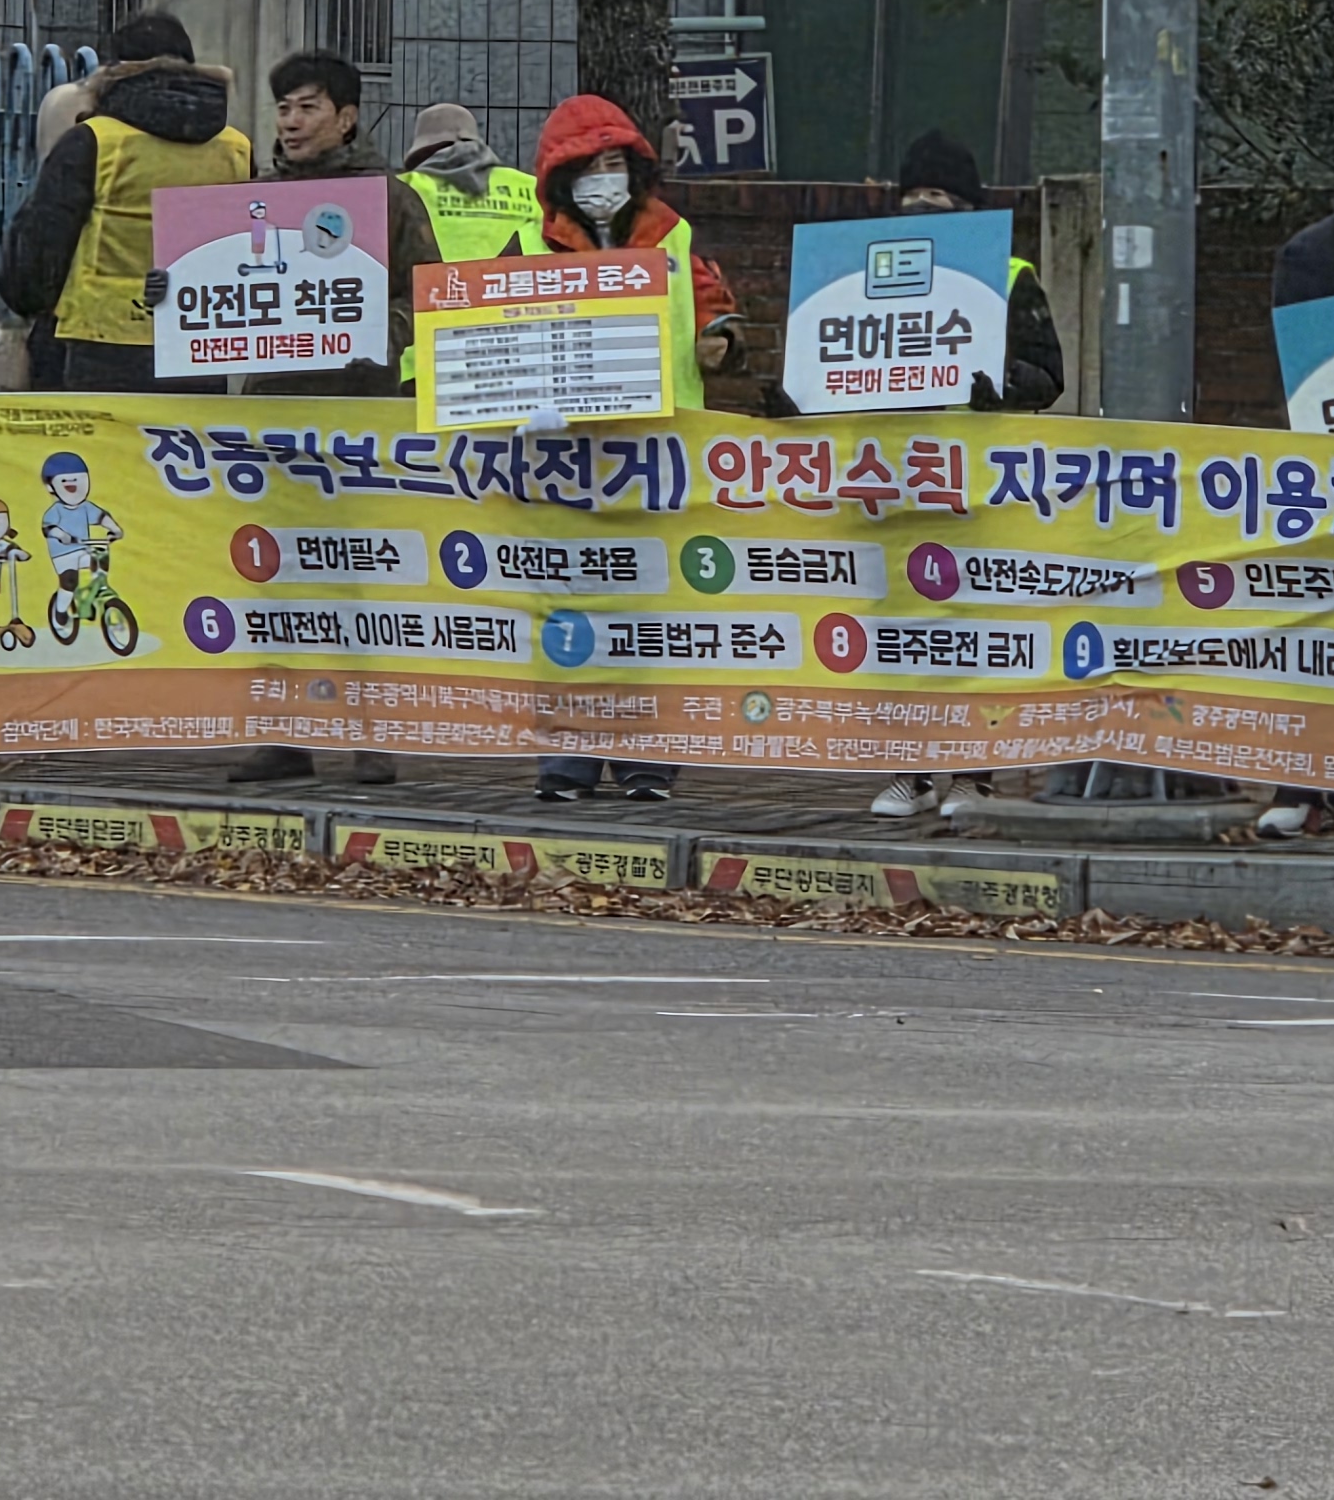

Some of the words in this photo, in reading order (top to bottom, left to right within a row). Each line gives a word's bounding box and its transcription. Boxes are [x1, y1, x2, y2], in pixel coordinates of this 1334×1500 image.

[713, 108, 757, 165] P
[597, 264, 651, 292] 준수
[176, 281, 282, 331] 안전모
[293, 276, 365, 323] 착용
[190, 335, 249, 363] 안전모
[321, 333, 352, 356] NO
[818, 308, 973, 363] 면허필수
[888, 365, 926, 392] 운전
[931, 364, 960, 387] NO
[707, 440, 968, 516] 안전수칙
[988, 447, 1177, 529] 지키며
[248, 537, 262, 569] 1
[296, 536, 402, 573] 면허필수
[454, 543, 474, 574] 2
[496, 543, 571, 583] 안전모
[580, 543, 638, 582] 착용
[697, 546, 716, 580] 3
[746, 547, 857, 586] 동승금지
[924, 554, 941, 586] 4
[1196, 566, 1216, 595] 5
[201, 608, 222, 640] 6
[607, 621, 722, 660] 교통법규
[731, 623, 786, 659] 준수
[831, 626, 851, 657] 8
[876, 629, 979, 668] 음주운전
[987, 631, 1035, 669] 금지
[1075, 635, 1091, 667] 9
